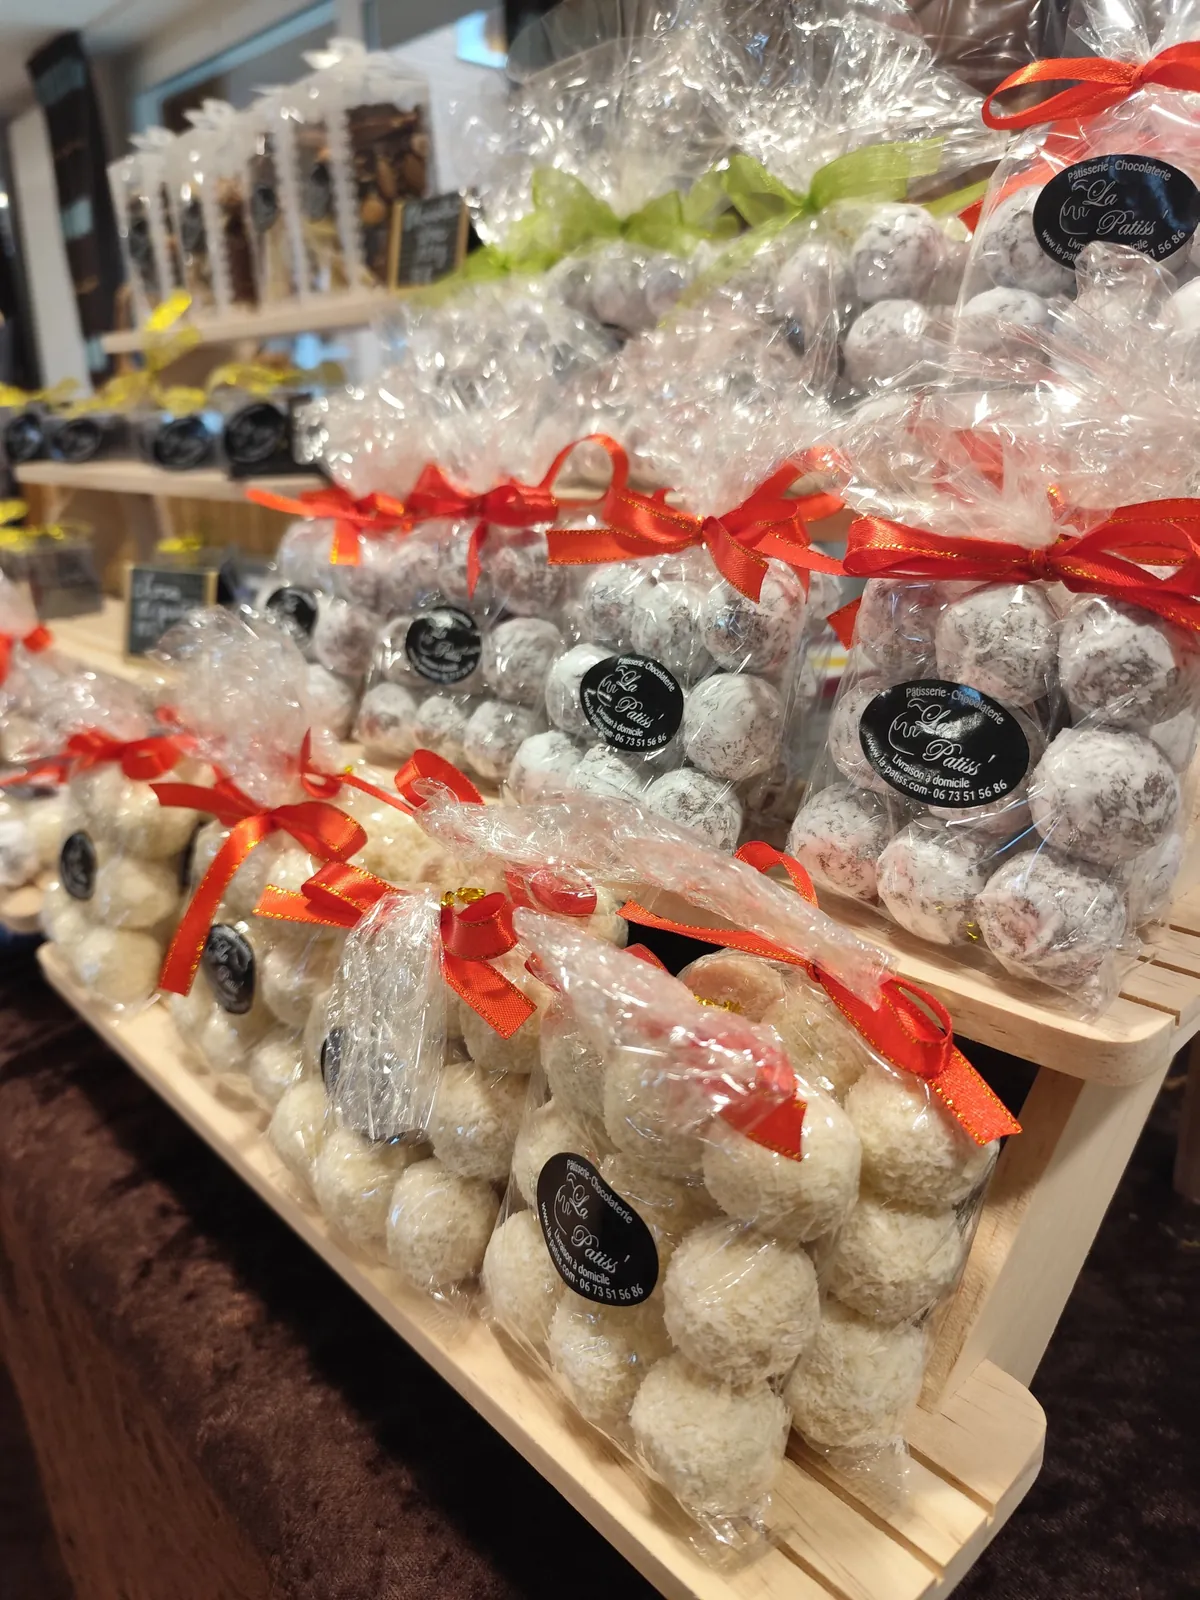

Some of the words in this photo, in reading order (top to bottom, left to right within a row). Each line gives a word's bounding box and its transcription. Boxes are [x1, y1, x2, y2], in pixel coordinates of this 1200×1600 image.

[1068, 162, 1108, 182] Pâtisserie
[1114, 160, 1171, 181] Chocolaterie
[1082, 179, 1117, 206] La
[1068, 237, 1084, 250] Livra
[1130, 240, 1148, 250] icile
[1158, 242, 1172, 254] 56
[1172, 230, 1186, 244] 86
[616, 671, 641, 692] La
[645, 662, 675, 692] Chocolaterie
[906, 687, 946, 698] Pâtisserie
[615, 733, 624, 743] 06
[626, 737, 634, 746] 73
[647, 738, 656, 746] 56
[658, 733, 666, 743] 86
[617, 723, 643, 736] domicile
[892, 753, 924, 779] Livraison
[925, 772, 930, 782] à
[932, 774, 970, 788] domicile
[933, 790, 945, 800] 06
[949, 791, 960, 801] 73
[964, 791, 974, 802] 51
[979, 786, 992, 799] 56
[992, 779, 1007, 794] 86
[567, 1159, 590, 1180] Pâtisserie
[591, 1176, 633, 1224] Chocolaterie
[569, 1184, 589, 1220] La
[554, 1228, 572, 1265] Livraison
[572, 1259, 578, 1270] à
[578, 1264, 610, 1285] domicile
[579, 1278, 590, 1292] 06
[593, 1284, 603, 1297] 73
[607, 1288, 616, 1299] 51
[619, 1288, 630, 1300] 56
[632, 1282, 643, 1297] 86
